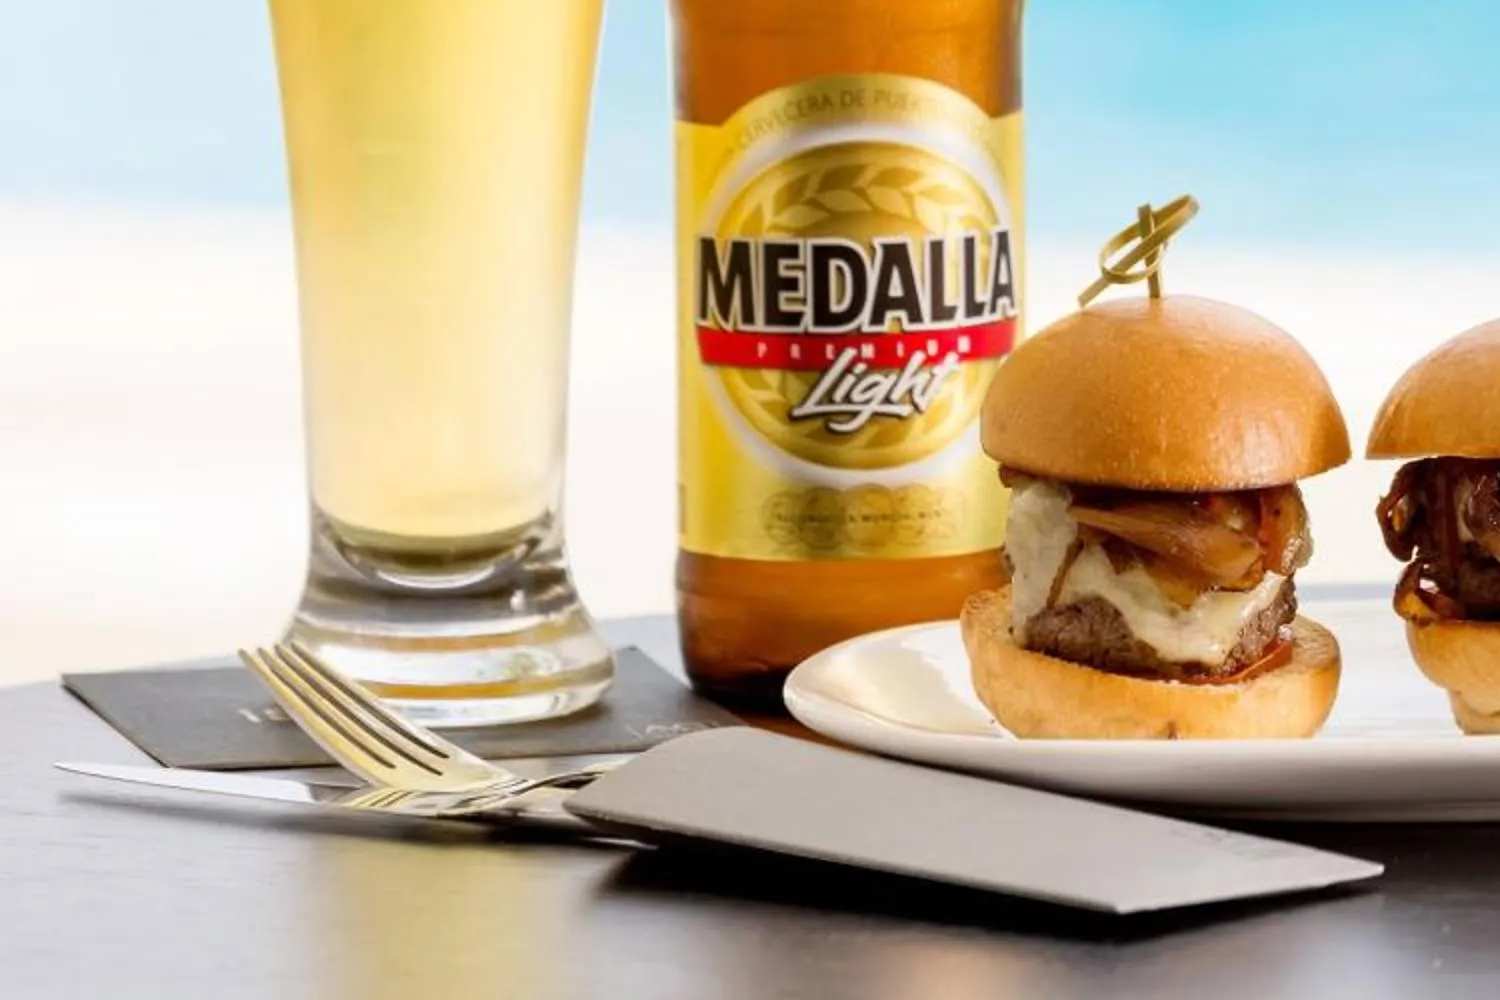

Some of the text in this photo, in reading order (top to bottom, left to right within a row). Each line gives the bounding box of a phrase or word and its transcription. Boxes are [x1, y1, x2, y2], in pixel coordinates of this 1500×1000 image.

[840, 88, 867, 112] DE
[697, 228, 1016, 331] MEDALLA
[790, 347, 961, 433] Light
